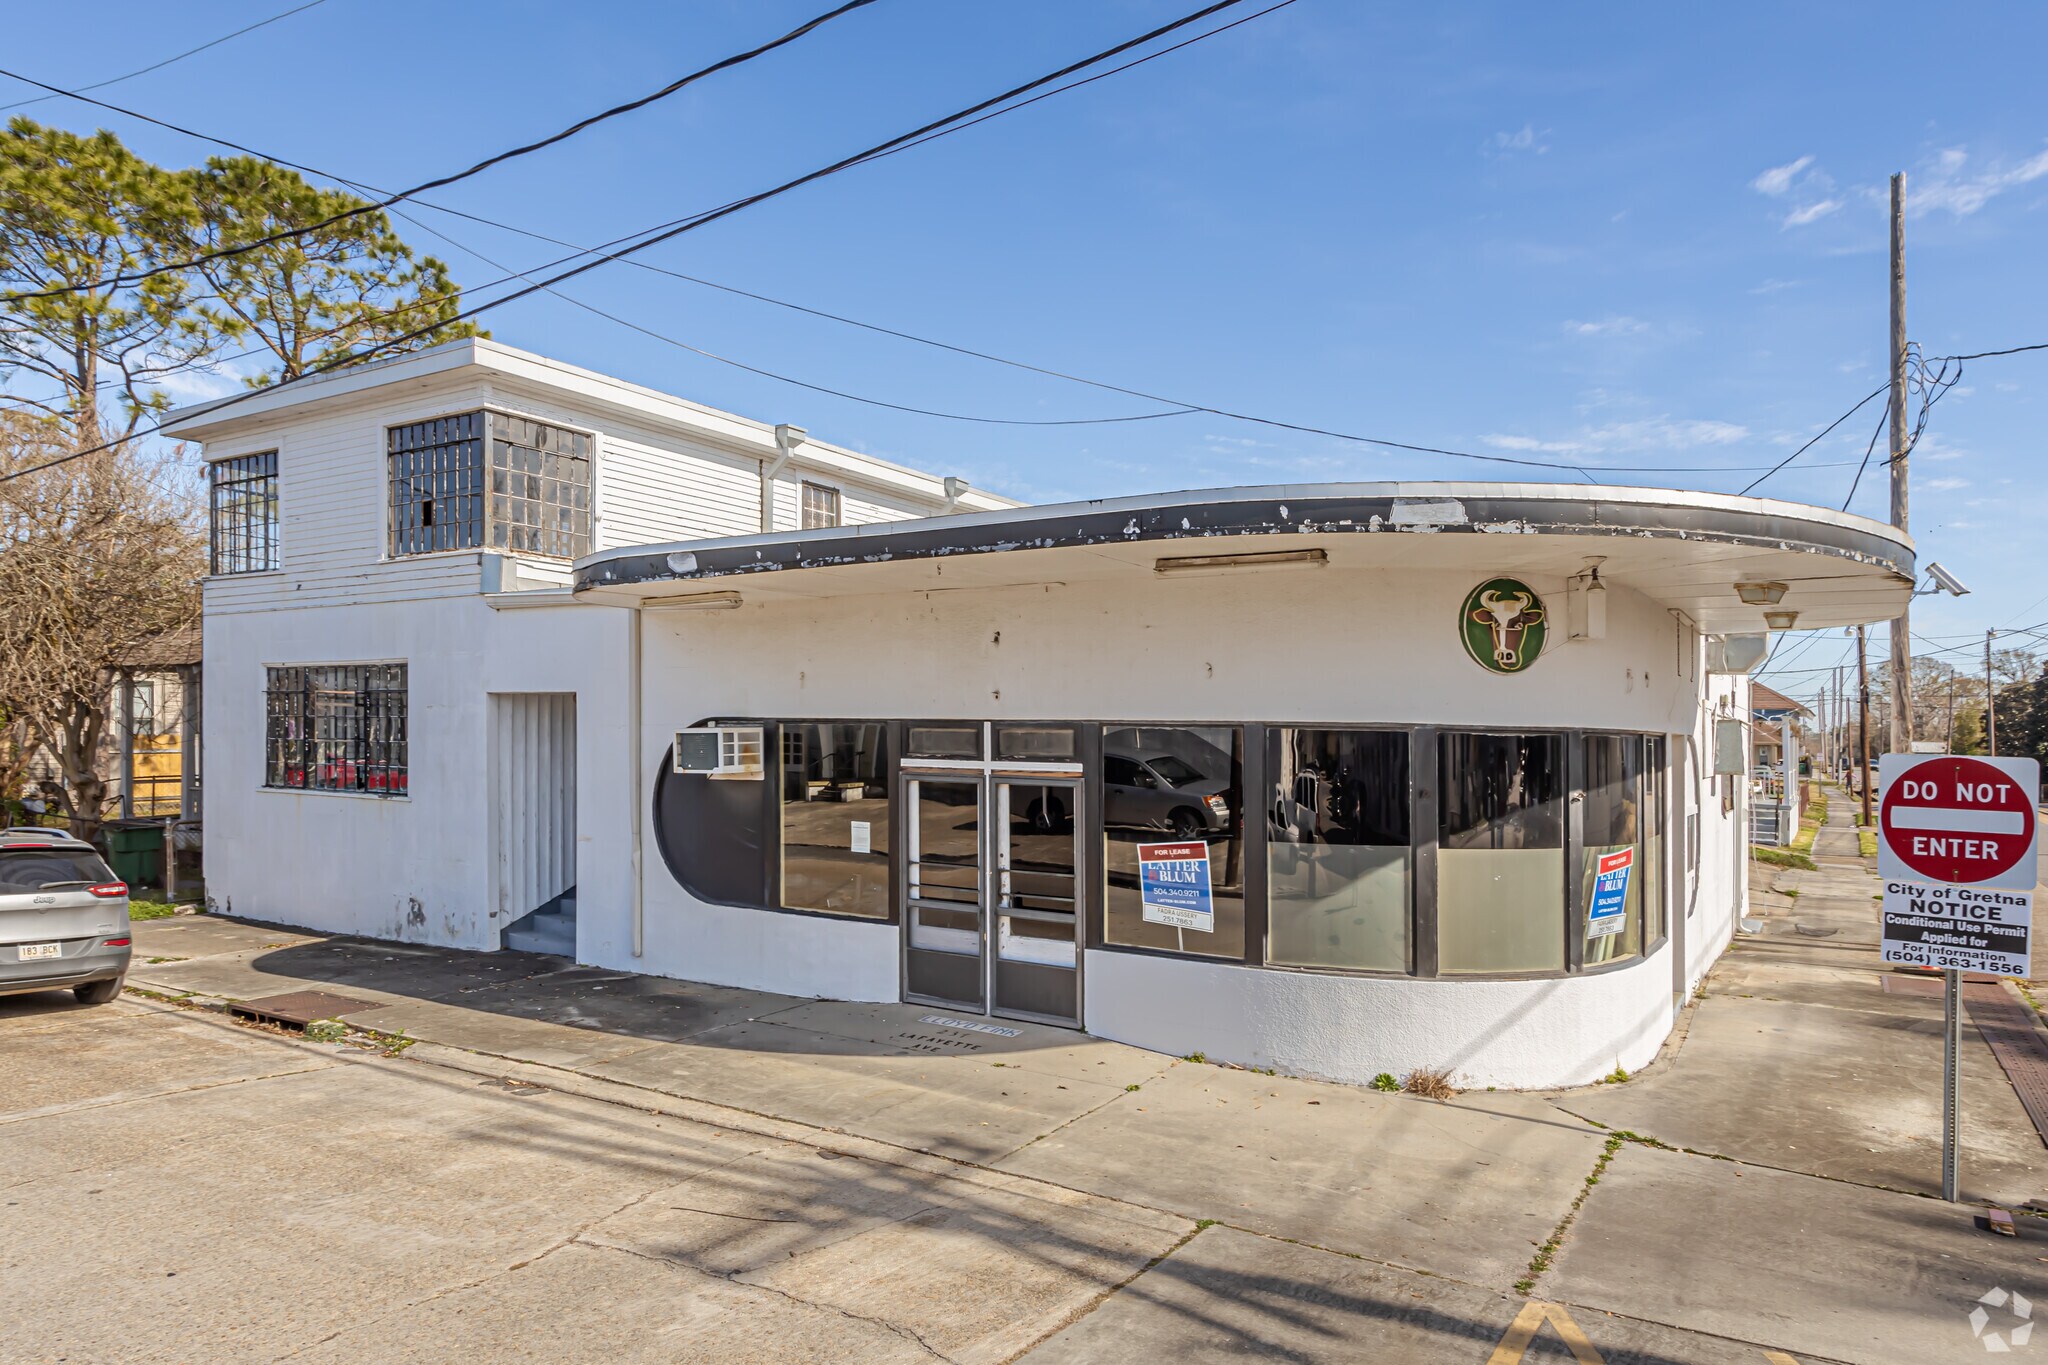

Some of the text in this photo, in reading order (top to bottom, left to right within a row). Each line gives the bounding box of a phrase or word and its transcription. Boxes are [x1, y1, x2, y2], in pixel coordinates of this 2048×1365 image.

[1903, 780, 2011, 804] DO NOT
[1912, 836, 1999, 861] ENTER
[1148, 860, 1202, 872] LATTER
[1159, 870, 1196, 883] BLUM
[33, 896, 56, 904] Jeep
[1154, 888, 1199, 897] 504.340.9211
[1887, 882, 2027, 907] City of Gretna
[1910, 899, 2002, 921] NOTICE
[1886, 914, 2026, 938] Conditional Use Permit
[1920, 931, 1989, 948] Applied for
[1902, 943, 2006, 962] For Information
[1886, 950, 2025, 975] (504) 363-1556
[899, 1032, 982, 1050] LAFAYETTE
[911, 1043, 941, 1053] AVE
